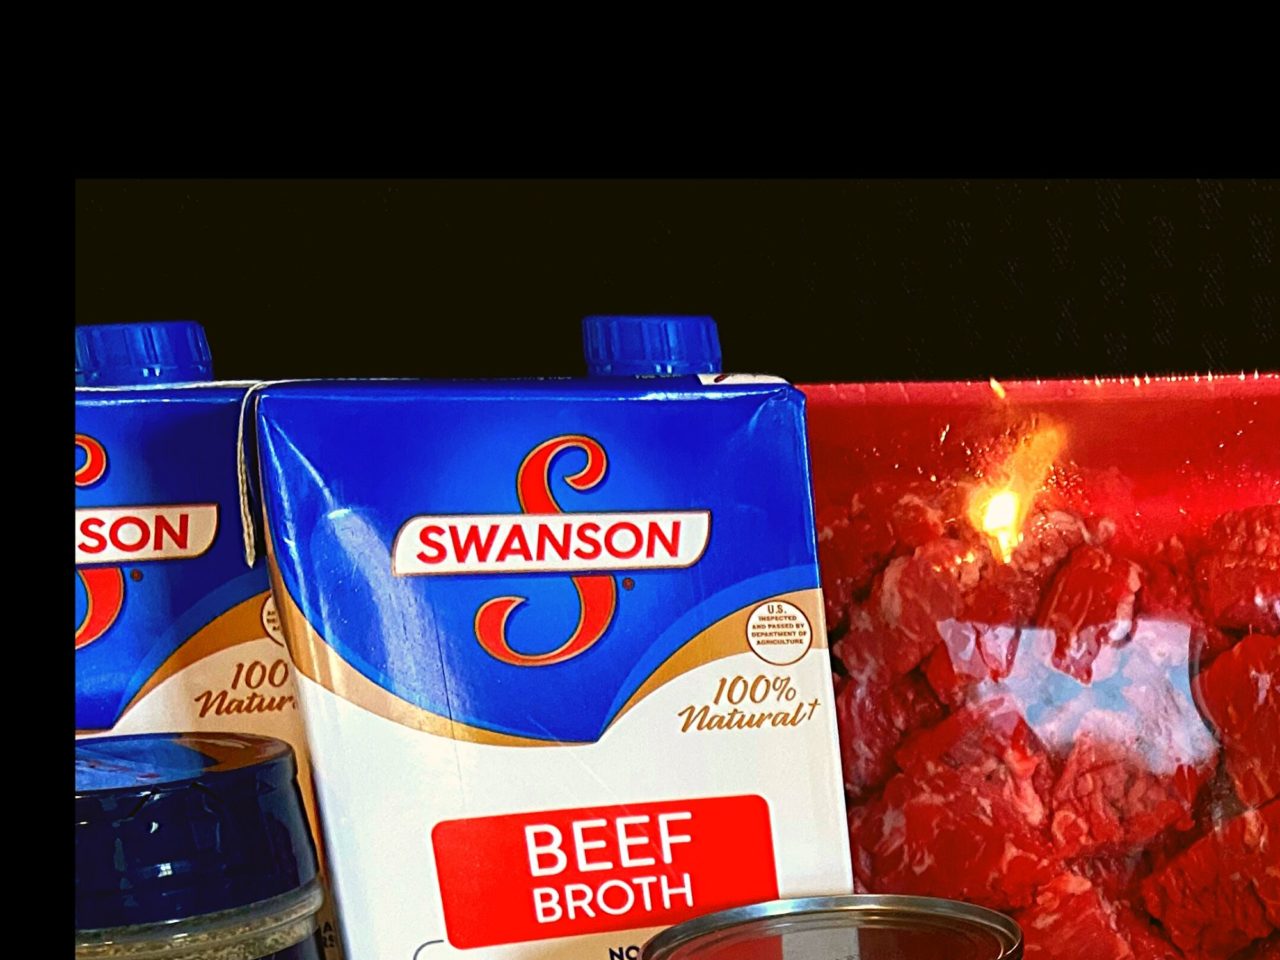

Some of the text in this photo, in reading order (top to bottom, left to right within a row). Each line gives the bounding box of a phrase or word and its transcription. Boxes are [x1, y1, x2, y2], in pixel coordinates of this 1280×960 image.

[416, 520, 682, 564] SWANSON
[767, 604, 787, 614] U.S.
[194, 691, 296, 718] Natur
[714, 674, 797, 706] 100%
[524, 811, 692, 877] BEEF
[533, 873, 694, 924] BROTH
